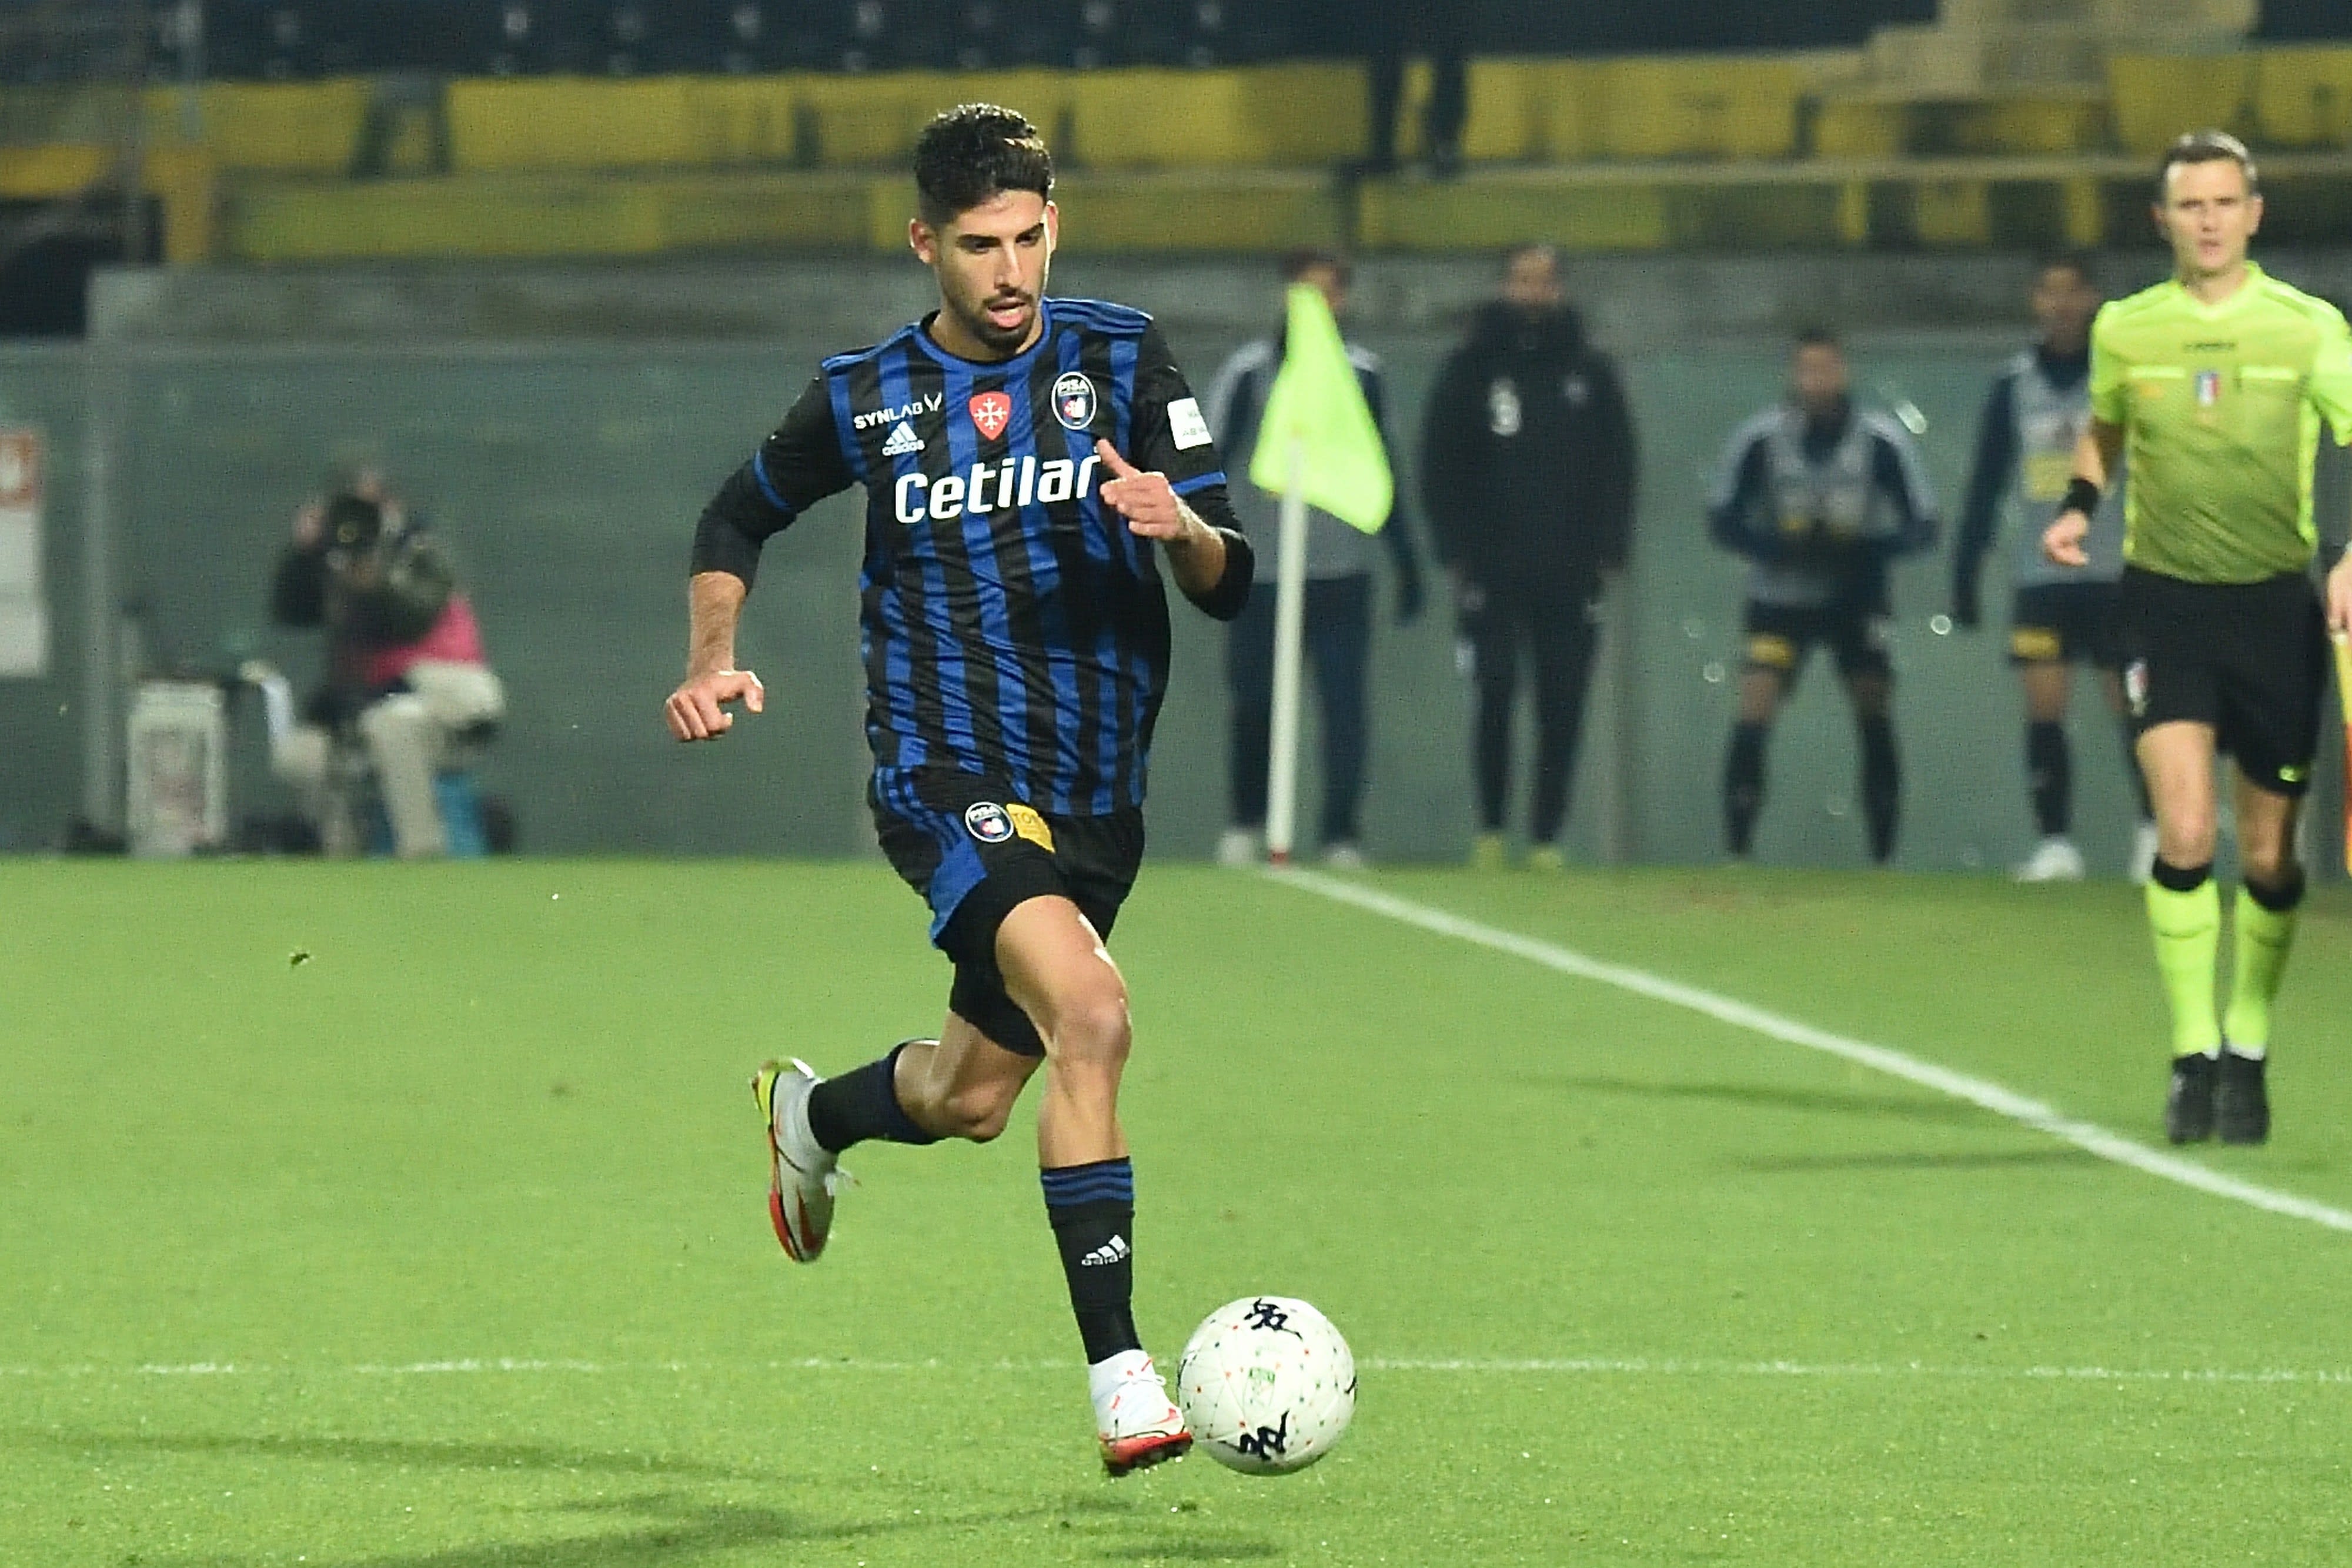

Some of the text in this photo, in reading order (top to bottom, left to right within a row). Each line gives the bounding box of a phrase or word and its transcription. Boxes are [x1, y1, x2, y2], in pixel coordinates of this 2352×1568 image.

[854, 402, 923, 429] SYNLAB
[882, 439, 926, 456] adidas
[895, 455, 1101, 523] Cetilar
